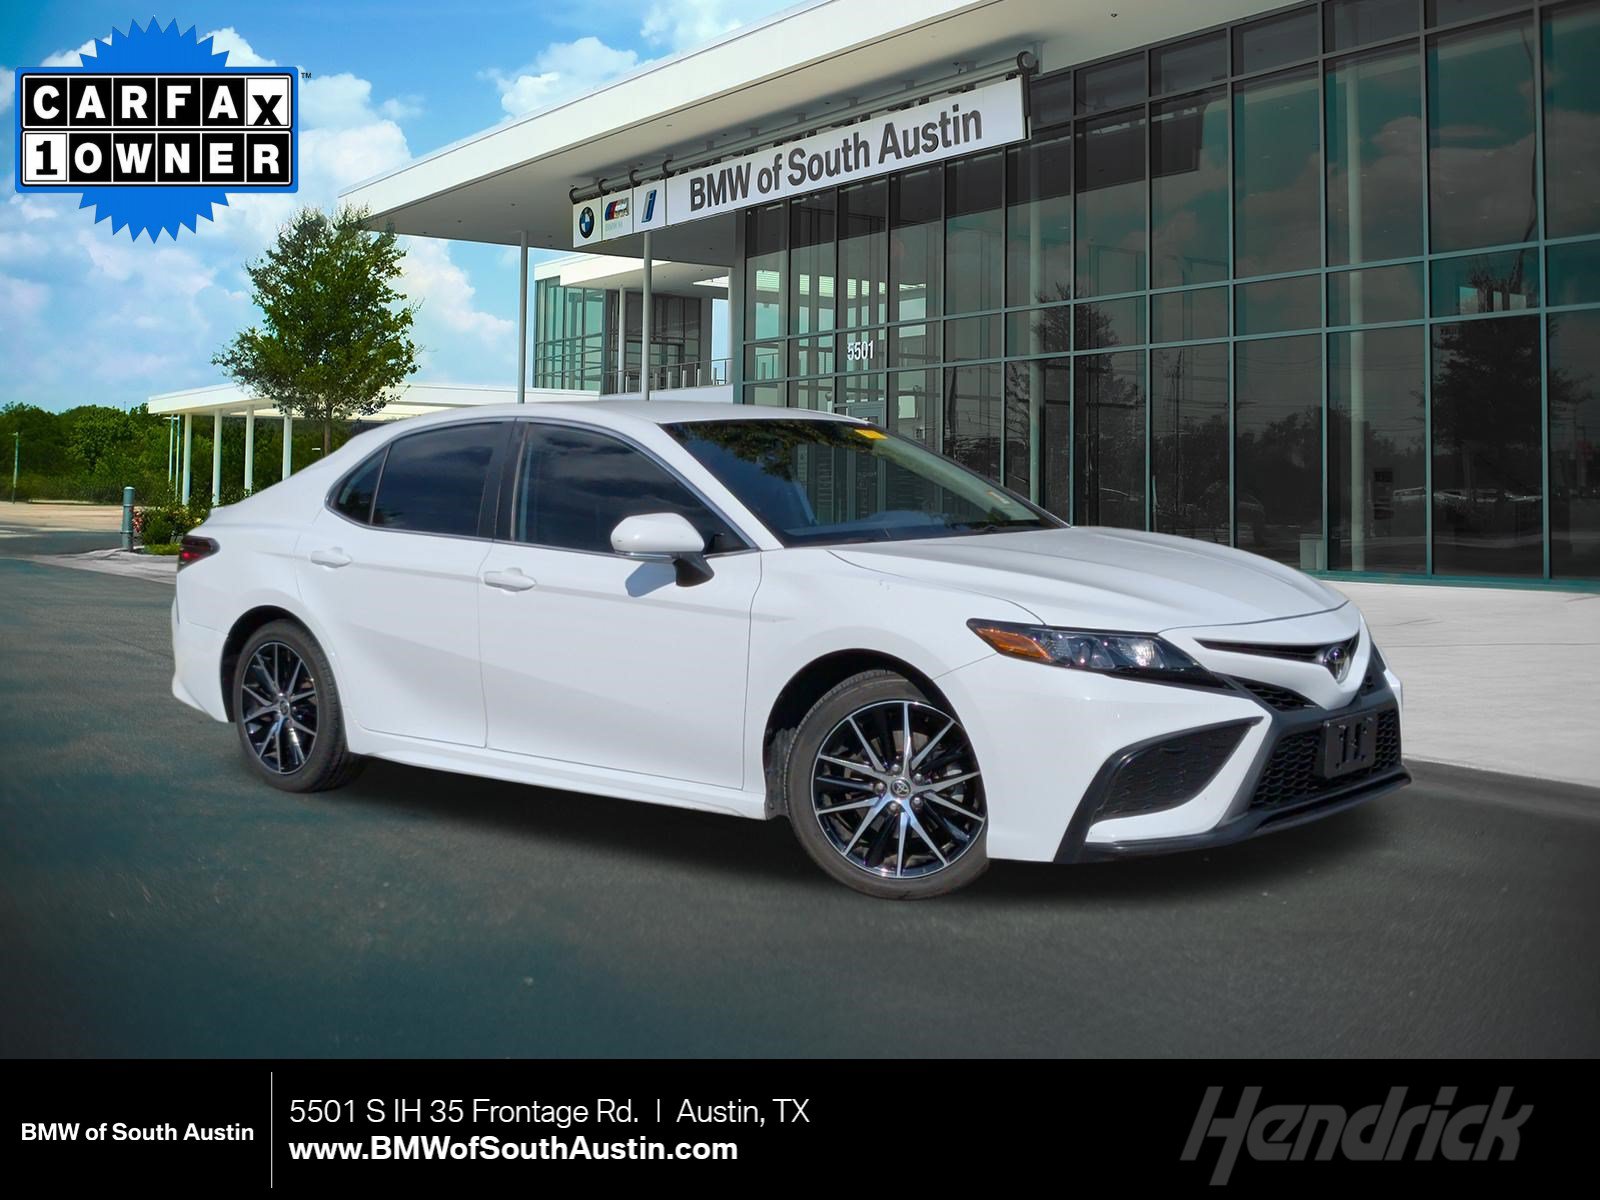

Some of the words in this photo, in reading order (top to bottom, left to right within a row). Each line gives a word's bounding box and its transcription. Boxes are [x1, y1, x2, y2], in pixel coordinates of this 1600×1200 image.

[690, 161, 752, 212] BMW
[757, 153, 783, 194] of
[787, 132, 871, 186] South
[878, 103, 983, 164] Austin
[847, 340, 874, 361] 5501
